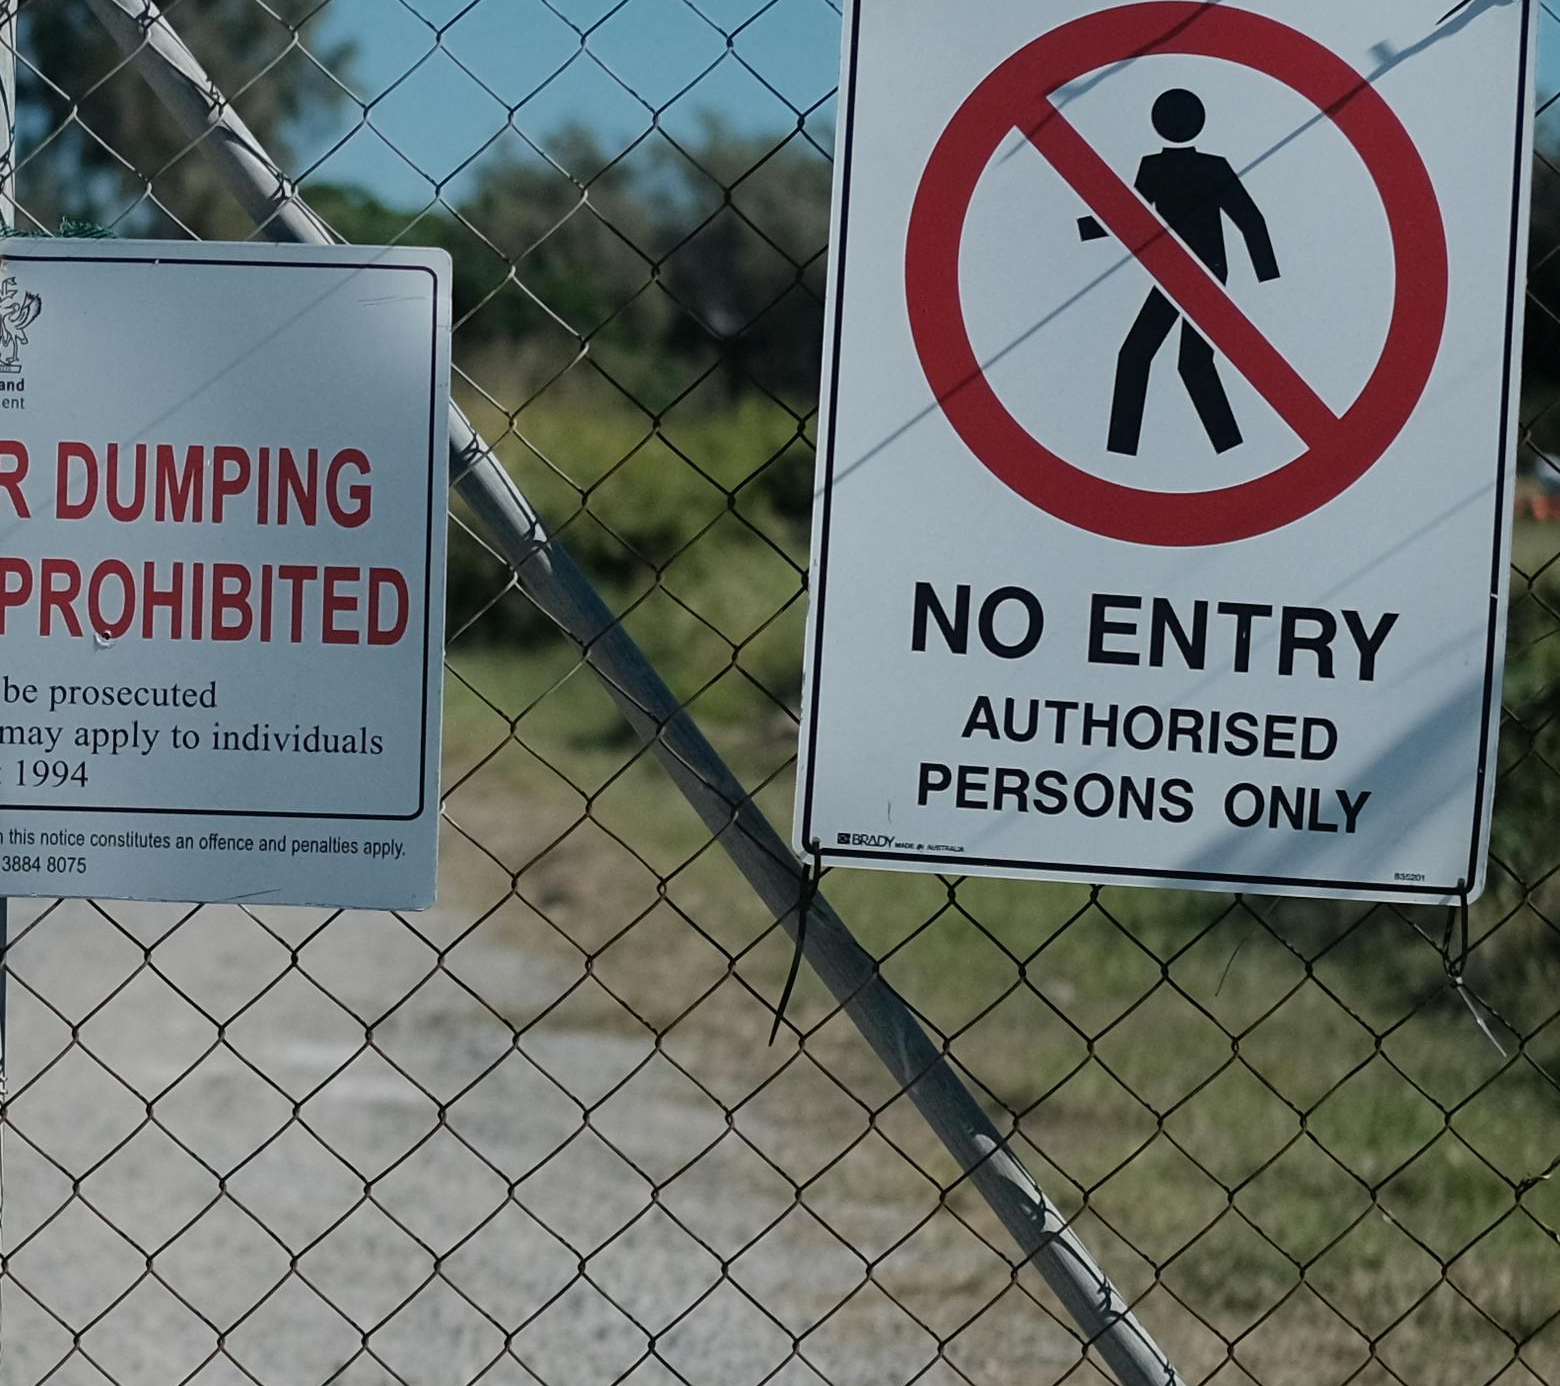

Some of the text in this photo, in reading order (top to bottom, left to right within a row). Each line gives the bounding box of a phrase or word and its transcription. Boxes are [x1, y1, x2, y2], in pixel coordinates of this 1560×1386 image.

[56, 441, 371, 528] DUMPING
[912, 582, 1399, 681] NO ENTRY
[3, 676, 37, 703] be
[50, 681, 216, 711] prosecuted
[75, 720, 159, 755] apply
[171, 725, 199, 749] to
[213, 722, 383, 754] individuals
[962, 696, 1337, 760] AUTHORISED
[18, 760, 88, 787] 1994
[918, 763, 1372, 833] PERSONS ONLY
[9, 829, 35, 845] this
[41, 829, 84, 846] notice
[91, 831, 170, 848] constitutes
[176, 837, 193, 849] an
[199, 833, 253, 851] offence
[259, 835, 286, 852] and
[292, 837, 358, 856] penalties
[364, 839, 405, 859] apply.
[852, 833, 895, 847] BRADY
[2, 856, 40, 872] 3884
[47, 856, 86, 873] 8075
